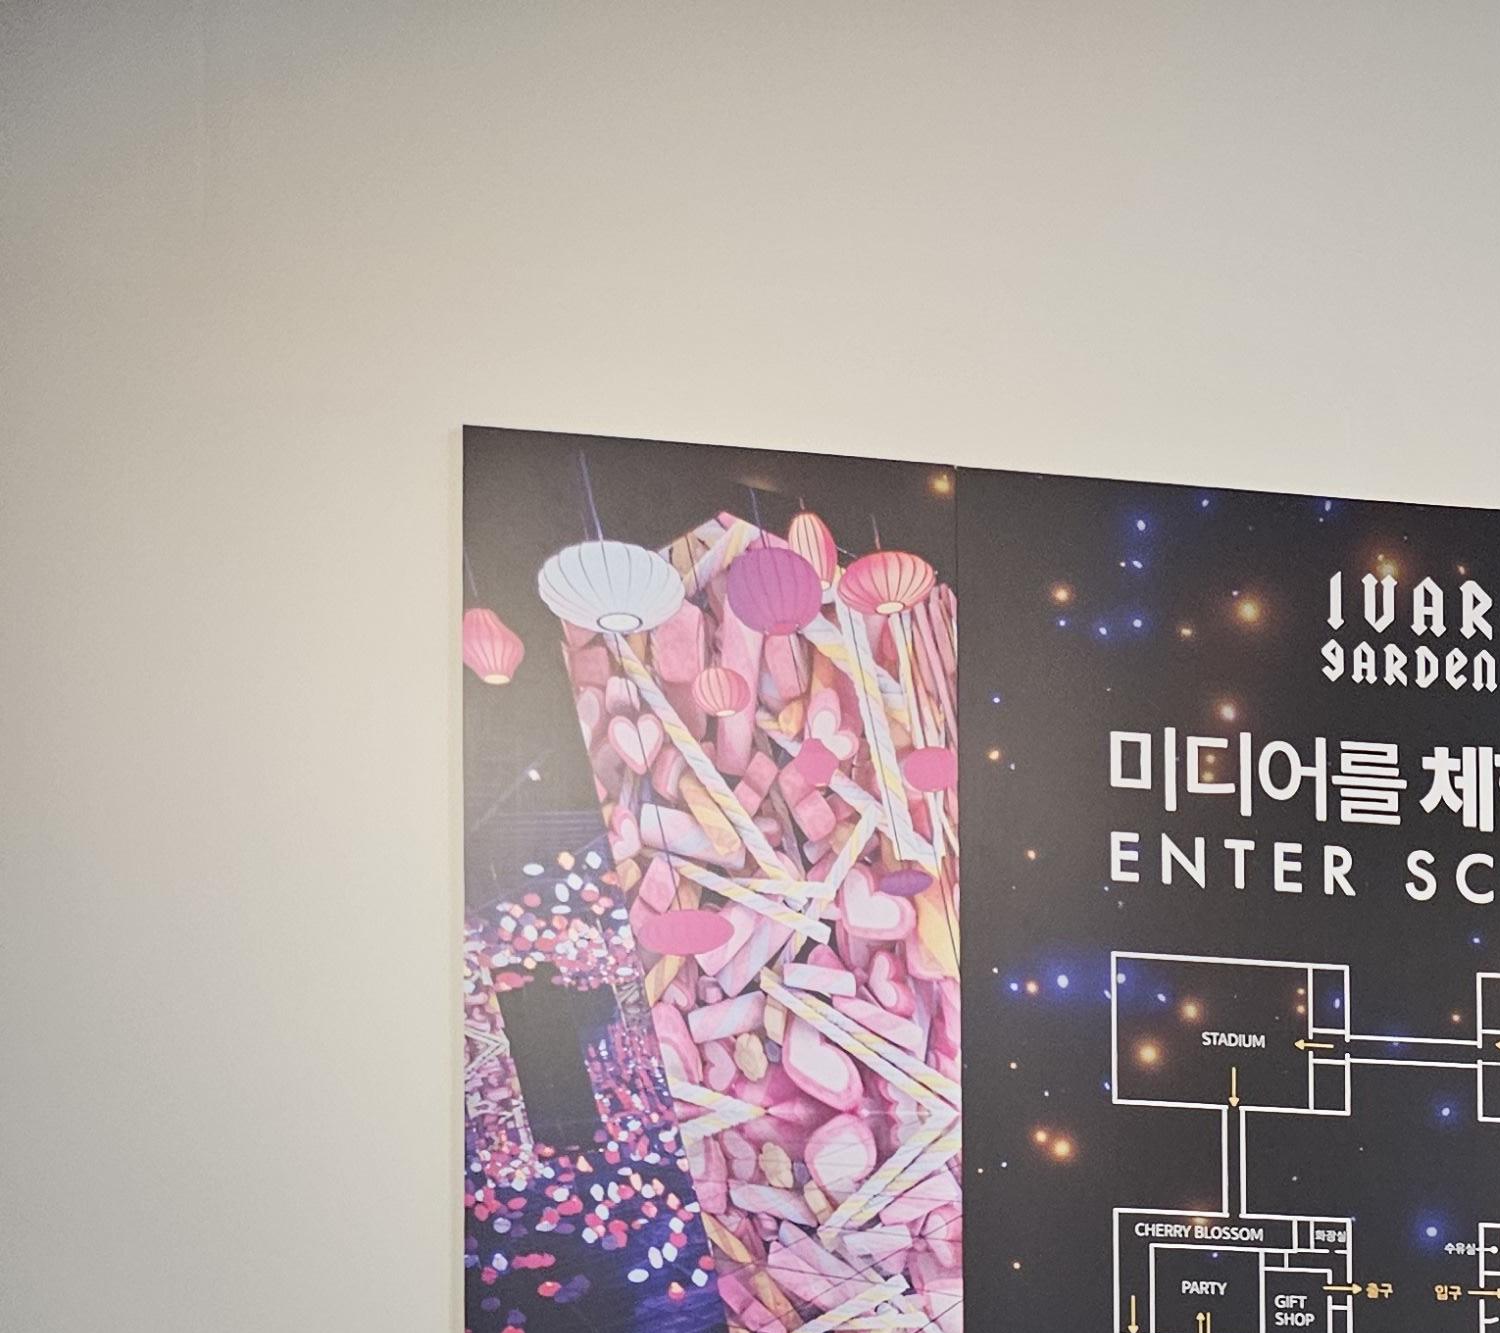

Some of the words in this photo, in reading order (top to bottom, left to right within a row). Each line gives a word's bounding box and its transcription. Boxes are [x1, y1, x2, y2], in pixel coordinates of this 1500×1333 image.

[1110, 727, 1407, 825] 미디어를
[1110, 831, 1357, 897] ENTER
[1201, 1031, 1266, 1049] STADIUM
[1134, 1222, 1191, 1240] CHERRY
[1194, 1224, 1264, 1242] BLOSSOM
[1181, 1280, 1228, 1297] PARTY
[1433, 1284, 1462, 1301] 입구
[1274, 1294, 1307, 1311] GIFT
[1274, 1311, 1315, 1327] SHOP
